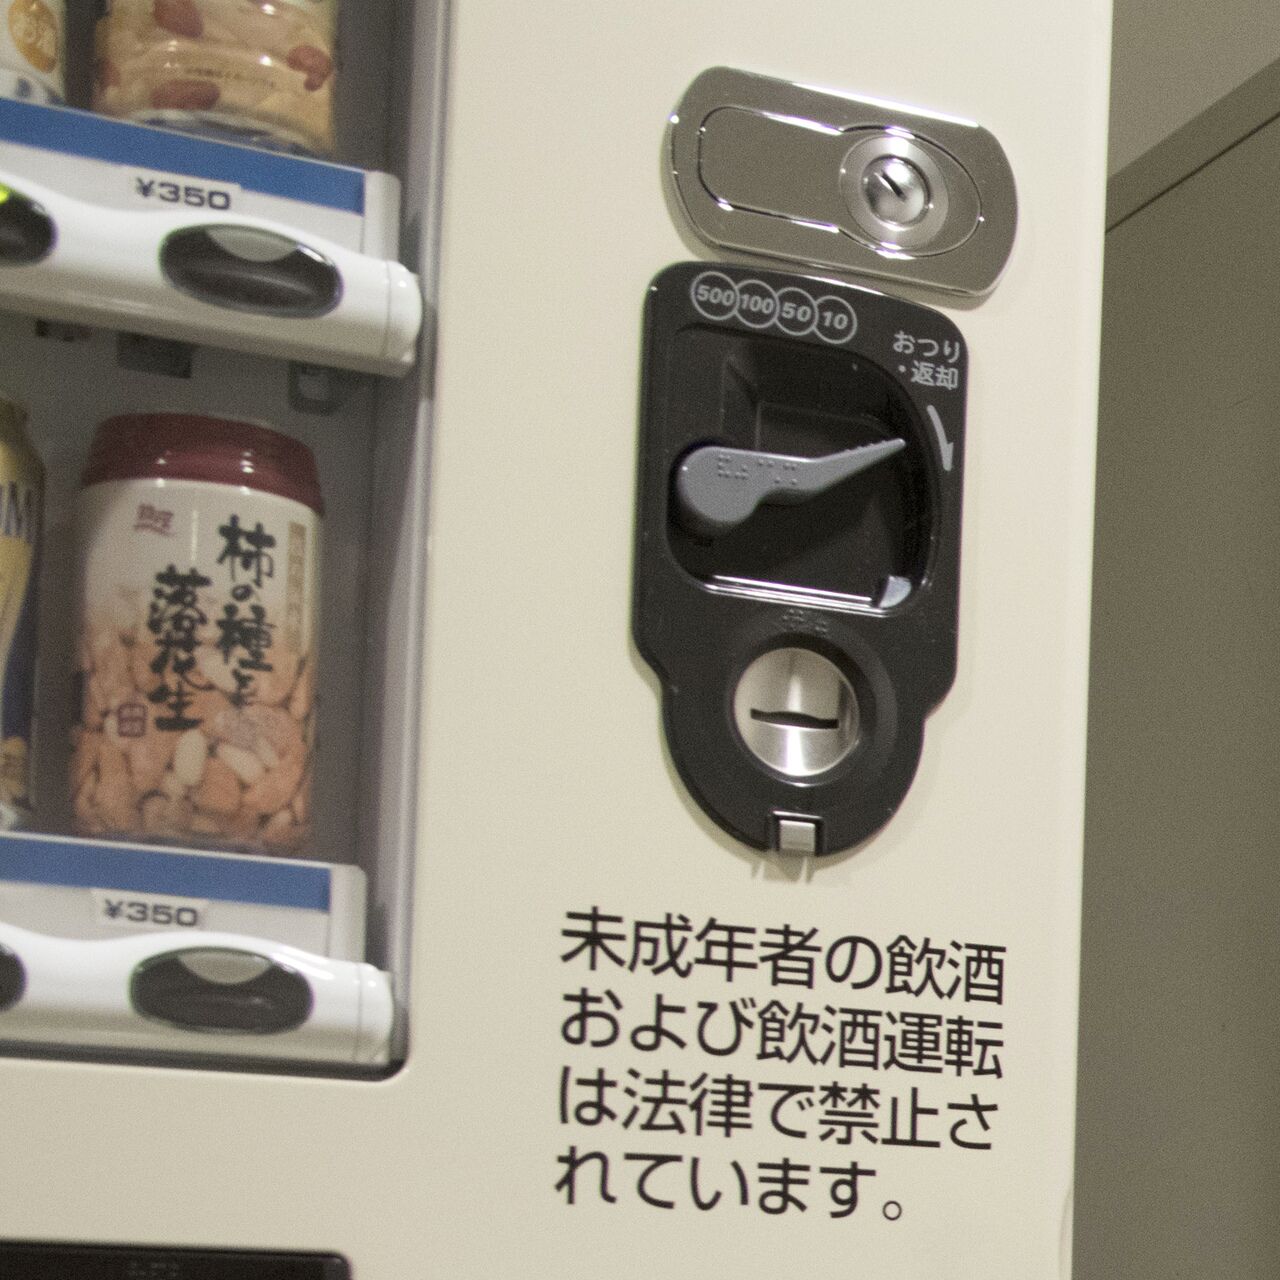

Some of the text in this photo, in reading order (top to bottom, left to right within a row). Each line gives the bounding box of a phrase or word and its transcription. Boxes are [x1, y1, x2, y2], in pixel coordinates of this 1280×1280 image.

[136, 176, 232, 211] ¥350
[697, 285, 848, 331] 500 100 50 10
[892, 331, 961, 363] おつり
[104, 897, 199, 928] ¥350
[560, 906, 1007, 1005] 未成年者の飲酒
[560, 988, 1005, 1080] および飲酒運転
[559, 1065, 999, 1150] は法律で禁止さ
[555, 1146, 903, 1221] れています。
